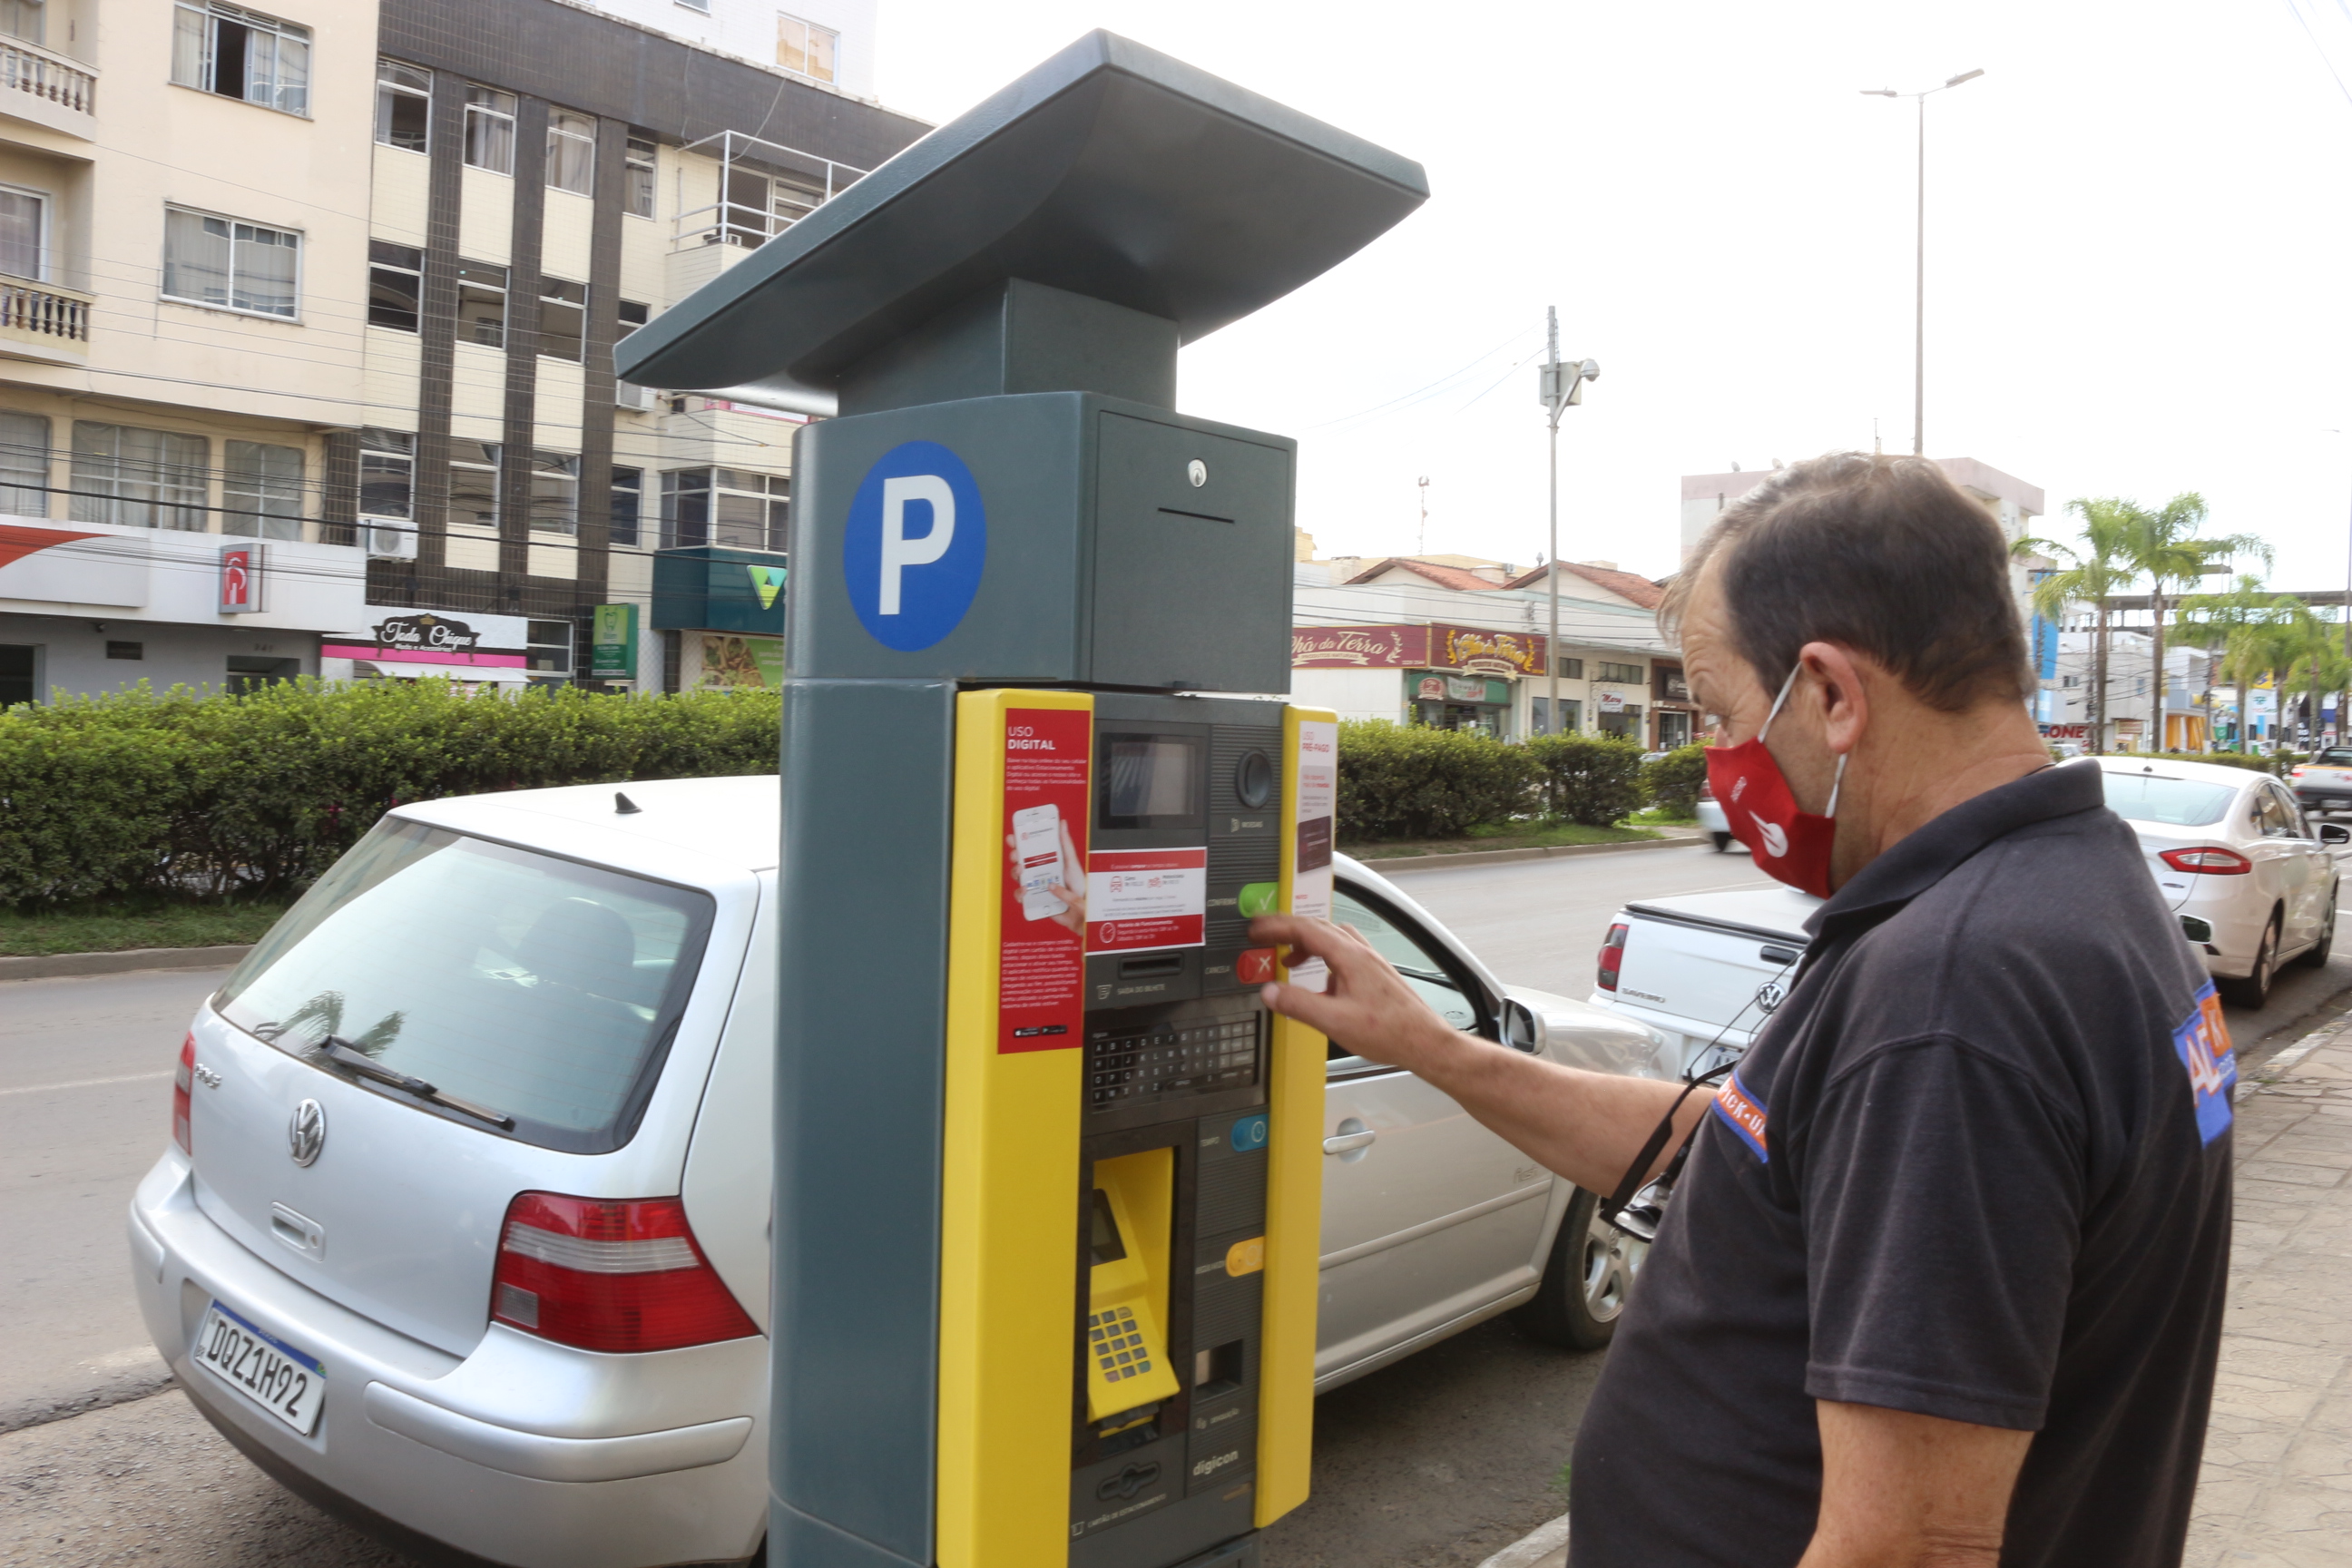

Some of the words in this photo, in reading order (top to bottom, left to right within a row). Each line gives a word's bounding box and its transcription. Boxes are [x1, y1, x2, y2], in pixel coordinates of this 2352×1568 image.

[879, 475, 956, 615] P
[381, 622, 421, 642] Toda
[429, 625, 472, 651] Chique
[1318, 637, 1337, 650] da
[1337, 631, 1388, 654] Terra
[1494, 634, 1526, 664] Terra
[1007, 726, 1034, 737] USO
[1007, 739, 1056, 750] DIGITAL
[1622, 987, 1666, 1004] SAVEIRO
[1192, 1450, 1239, 1476] digicon
